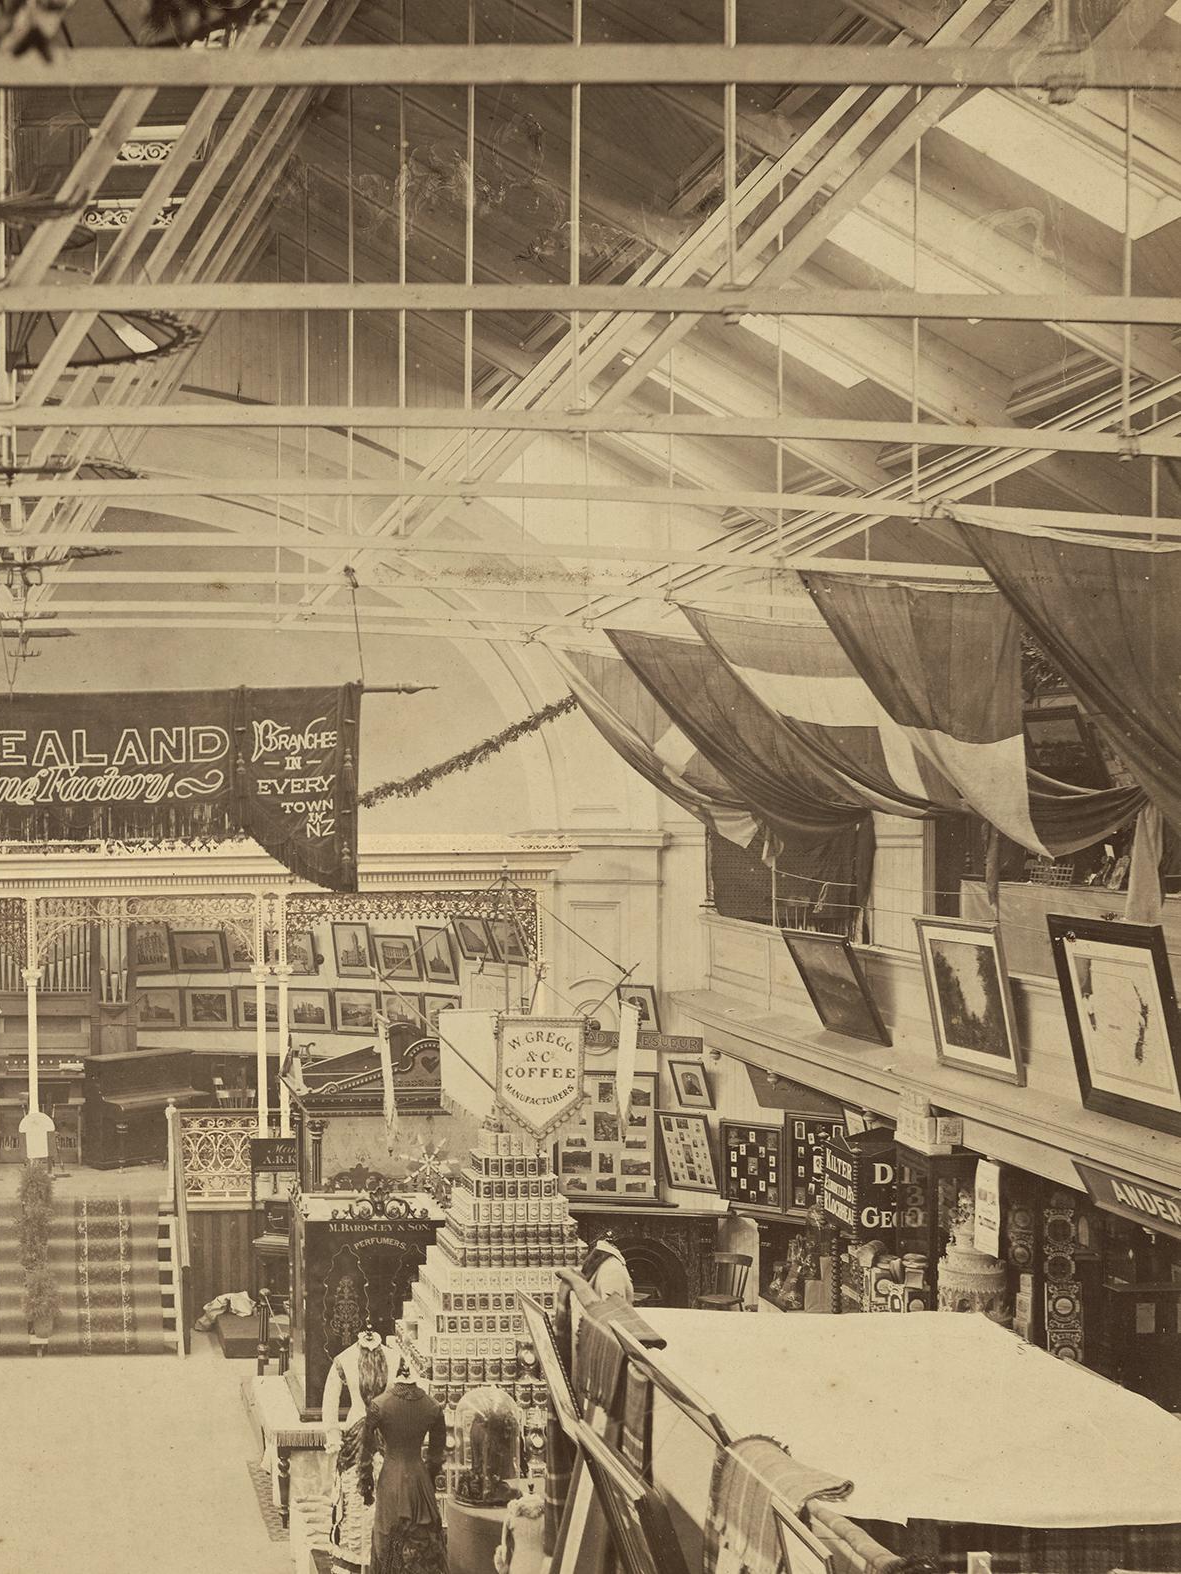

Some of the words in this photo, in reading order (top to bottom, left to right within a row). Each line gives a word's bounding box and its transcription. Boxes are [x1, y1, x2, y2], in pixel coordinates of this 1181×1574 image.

[284, 756, 302, 770] IN
[257, 775, 336, 794] EVERY
[281, 799, 333, 813] TOWN
[308, 812, 326, 824] IN
[307, 819, 335, 838] NZ
[525, 1031, 573, 1052] GREGG
[505, 1066, 576, 1079] COFFEE
[505, 1083, 575, 1105] MANUFACTURERS
[353, 1236, 407, 1250] PERFUMERS
